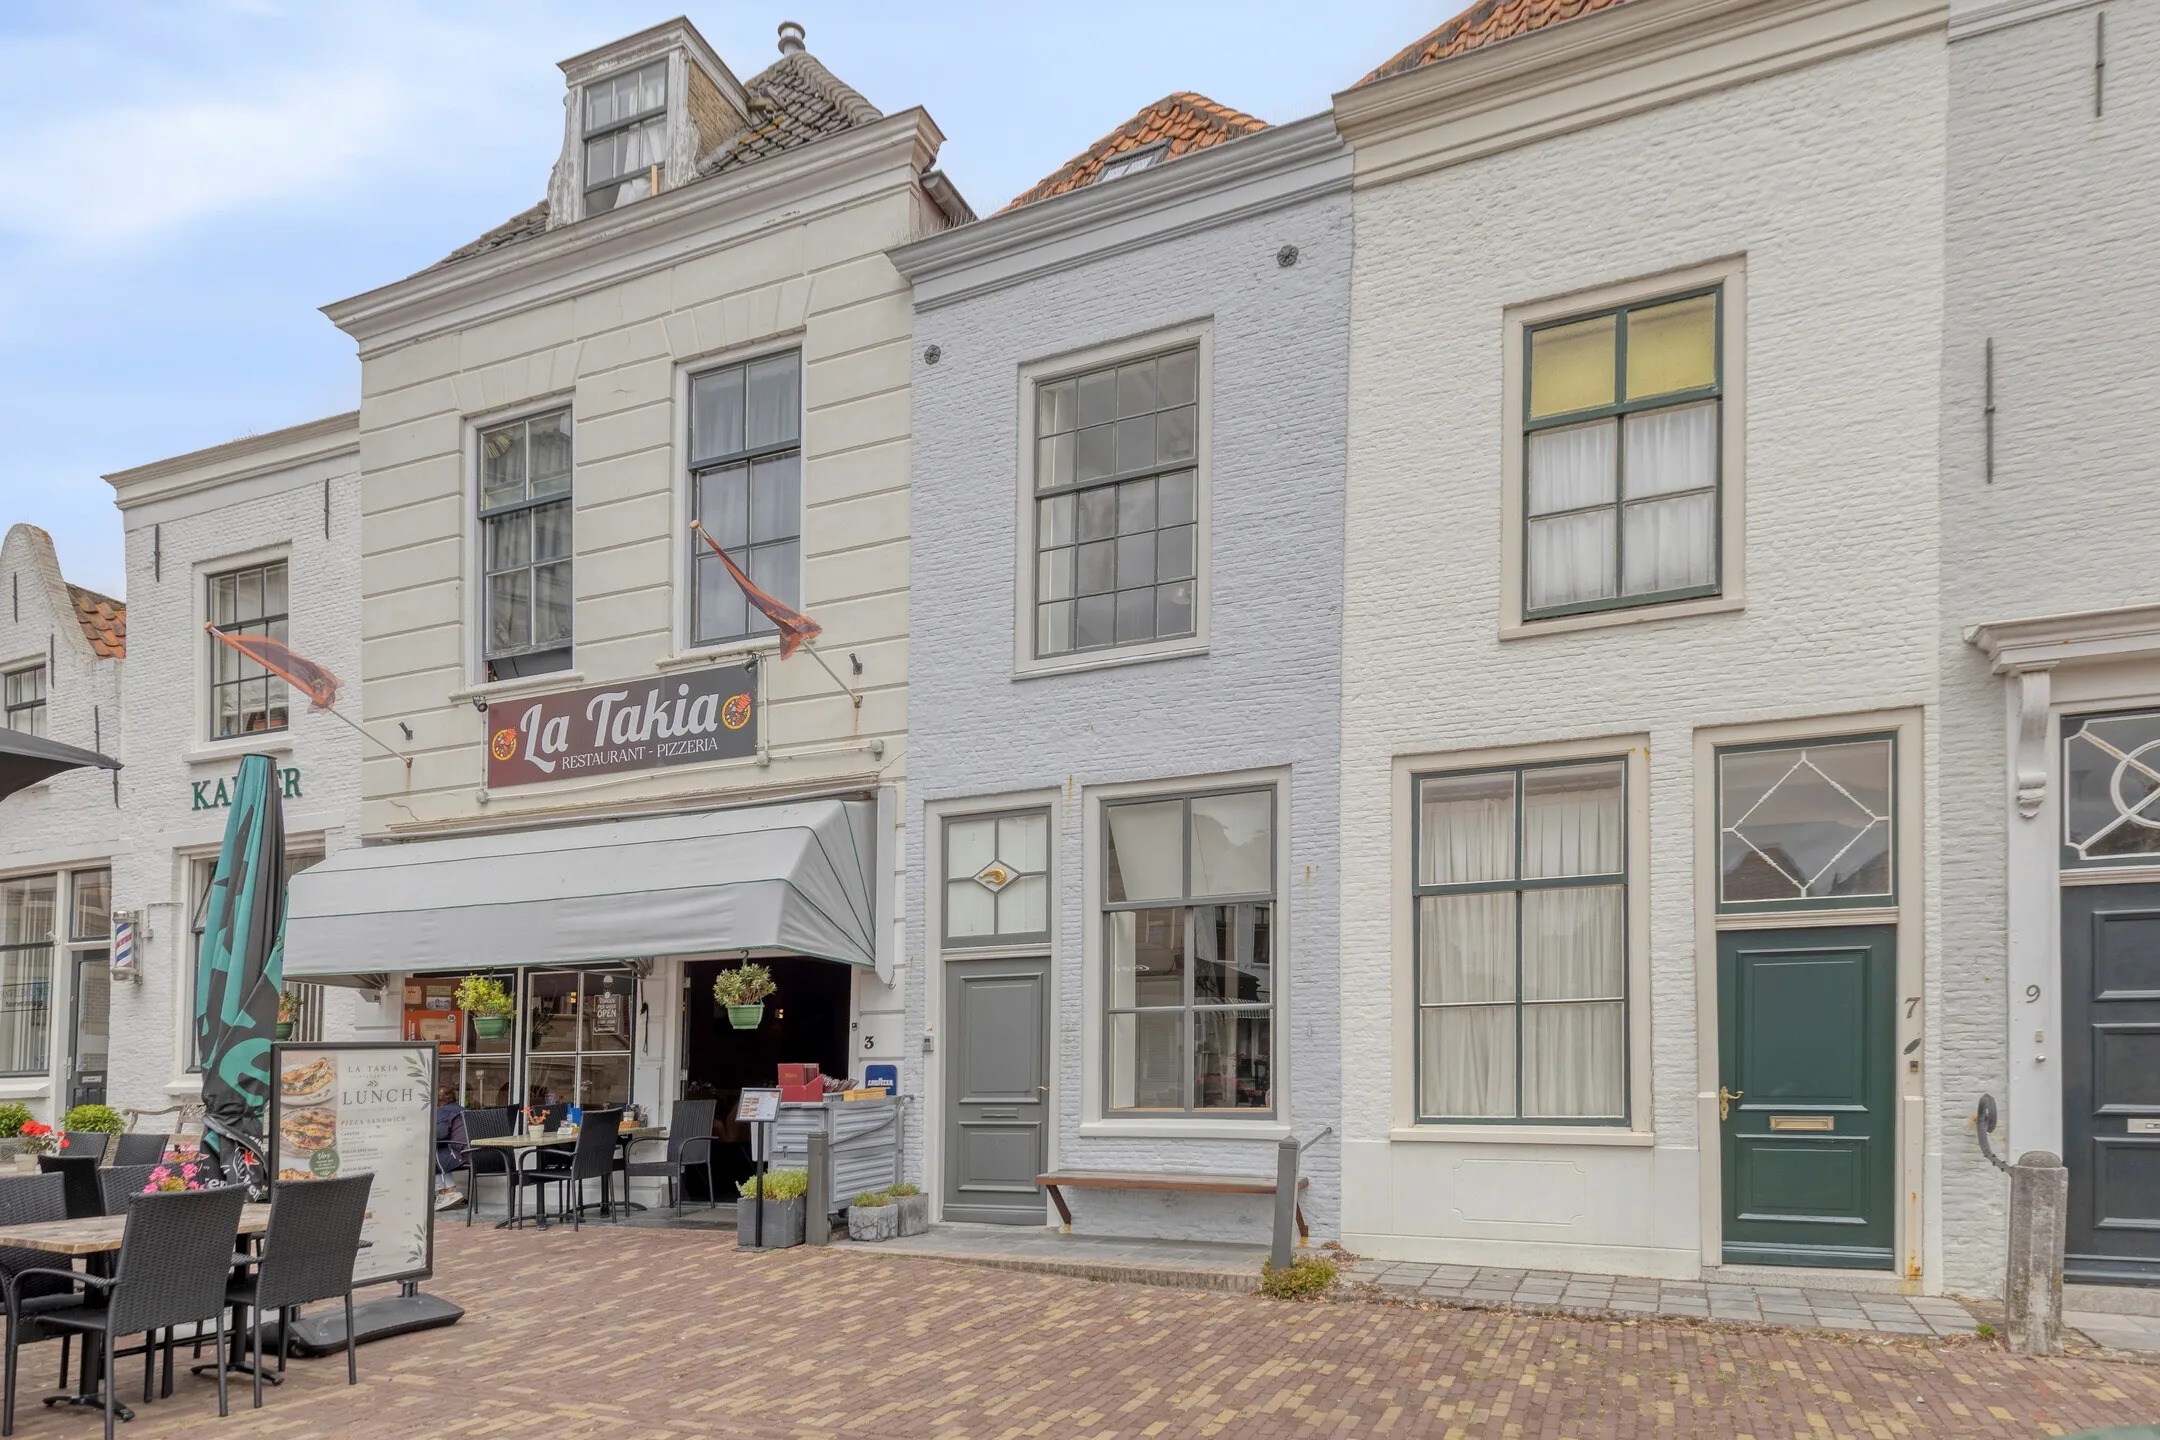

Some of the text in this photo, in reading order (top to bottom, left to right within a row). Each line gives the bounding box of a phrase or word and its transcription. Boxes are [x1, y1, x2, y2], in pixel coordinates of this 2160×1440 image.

[520, 683, 719, 773] La Takia
[562, 746, 646, 769] RESTAURANT
[657, 737, 718, 758] PIZZERIA
[2026, 984, 2041, 1003] 9
[597, 1009, 617, 1018] OPEN
[1904, 997, 1921, 1018] 7
[864, 1035, 875, 1050] 3
[368, 1064, 398, 1073] TAKIA
[343, 1088, 413, 1105] LUNCH
[367, 1116, 406, 1124] SANDWICH
